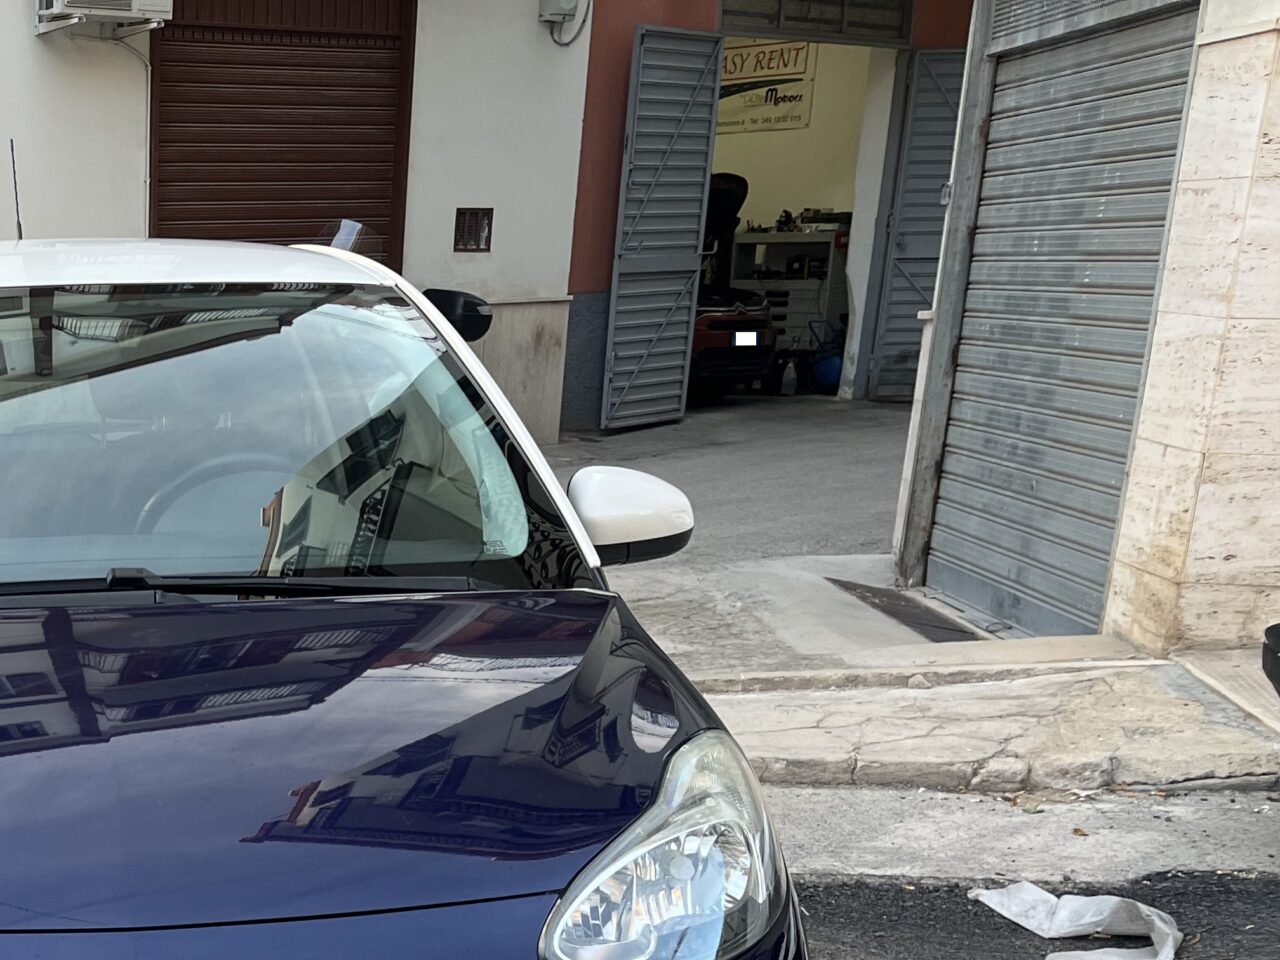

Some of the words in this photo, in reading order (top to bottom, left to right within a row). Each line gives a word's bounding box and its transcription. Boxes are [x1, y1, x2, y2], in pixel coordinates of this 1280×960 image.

[722, 52, 751, 74] ASY
[753, 45, 806, 72] RENT
[764, 87, 803, 106] Motors
